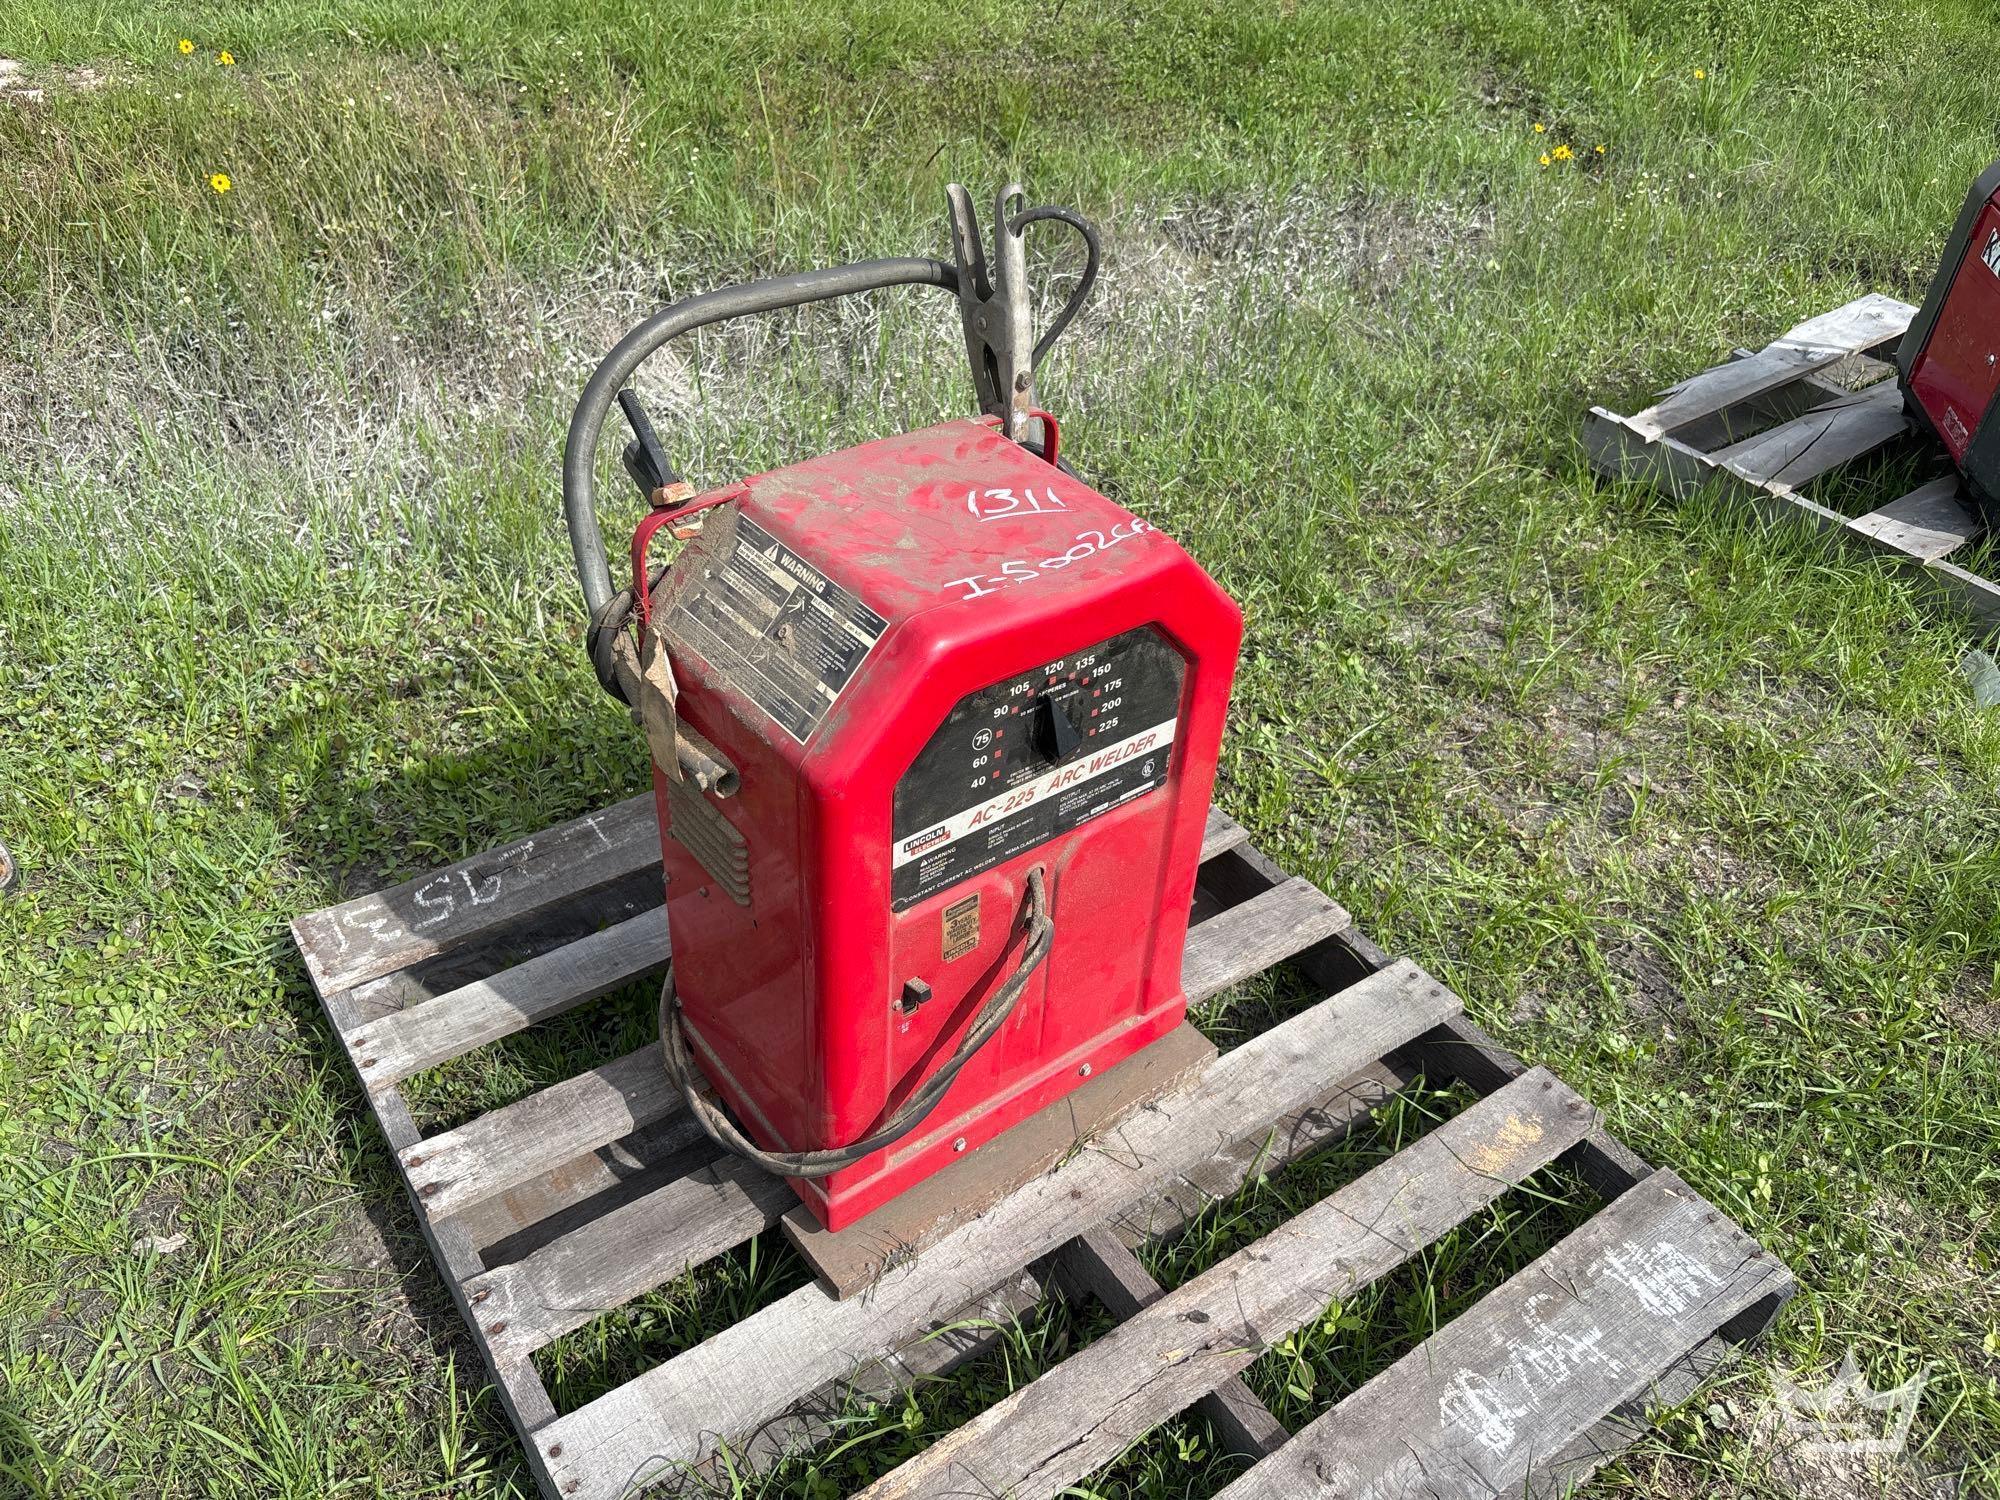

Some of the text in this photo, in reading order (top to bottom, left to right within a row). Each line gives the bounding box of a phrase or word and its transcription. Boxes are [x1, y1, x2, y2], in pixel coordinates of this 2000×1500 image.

[781, 553, 826, 593] WARNING
[1010, 655, 1095, 697] 105 120 135
[1092, 662, 1112, 678] 150
[994, 678, 1122, 718] 90 175
[1102, 697, 1122, 713] 200
[976, 717, 1119, 746] 75 225
[972, 755, 988, 769] 60
[968, 787, 1036, 828] AC-225
[1046, 764, 1085, 794] ARC
[1089, 733, 1157, 775] WELDER
[971, 776, 986, 790] 40
[1060, 789, 1081, 802] OUTPUT
[988, 824, 1005, 835] INPUT
[905, 829, 944, 851] LINCOLN
[915, 834, 946, 854] ELECTRIC
[927, 847, 956, 864] WARNING
[904, 886, 936, 902] CONSTANT
[937, 872, 964, 888] CURRENT
[973, 857, 996, 870] WELDER
